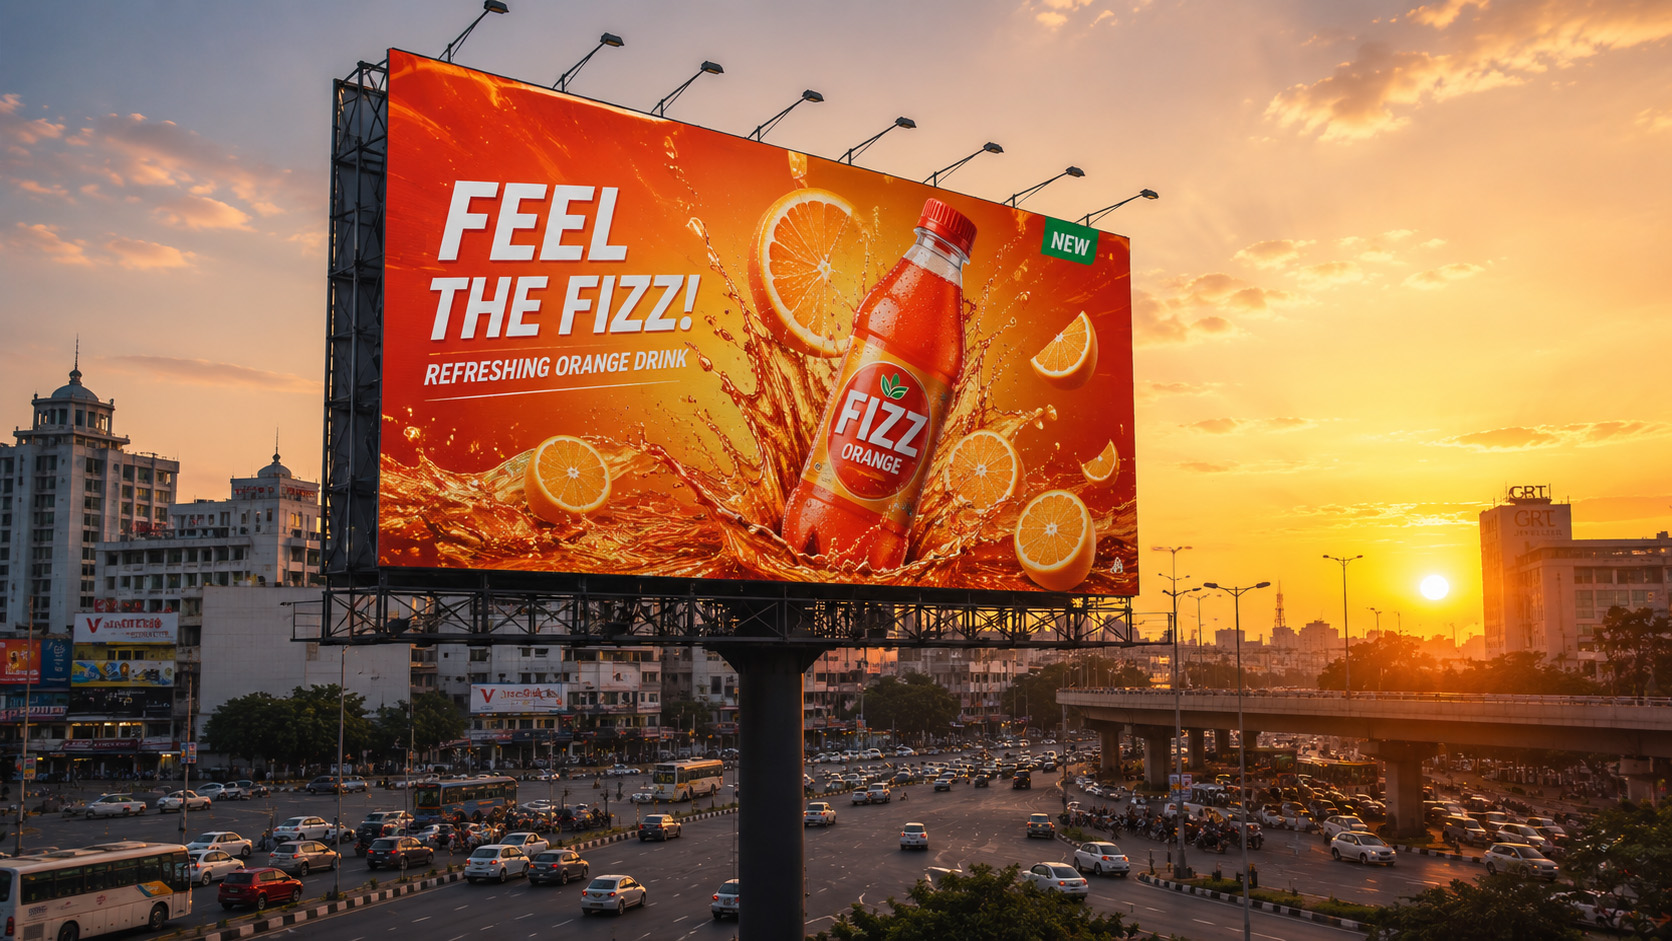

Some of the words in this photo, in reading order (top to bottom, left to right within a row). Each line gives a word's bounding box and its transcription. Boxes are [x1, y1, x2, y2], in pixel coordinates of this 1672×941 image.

[437, 180, 628, 261] FEEL
[1050, 231, 1091, 257] NEW
[429, 276, 549, 341] THE
[558, 274, 701, 335] FIZZ!
[423, 357, 551, 386] REFRESHING
[555, 352, 631, 377] ORANGE
[633, 348, 689, 371] DRINK
[834, 389, 928, 459] FIZZ
[841, 443, 903, 476] ORANGE
[1508, 485, 1547, 499] GRT
[1514, 510, 1556, 527] GRT
